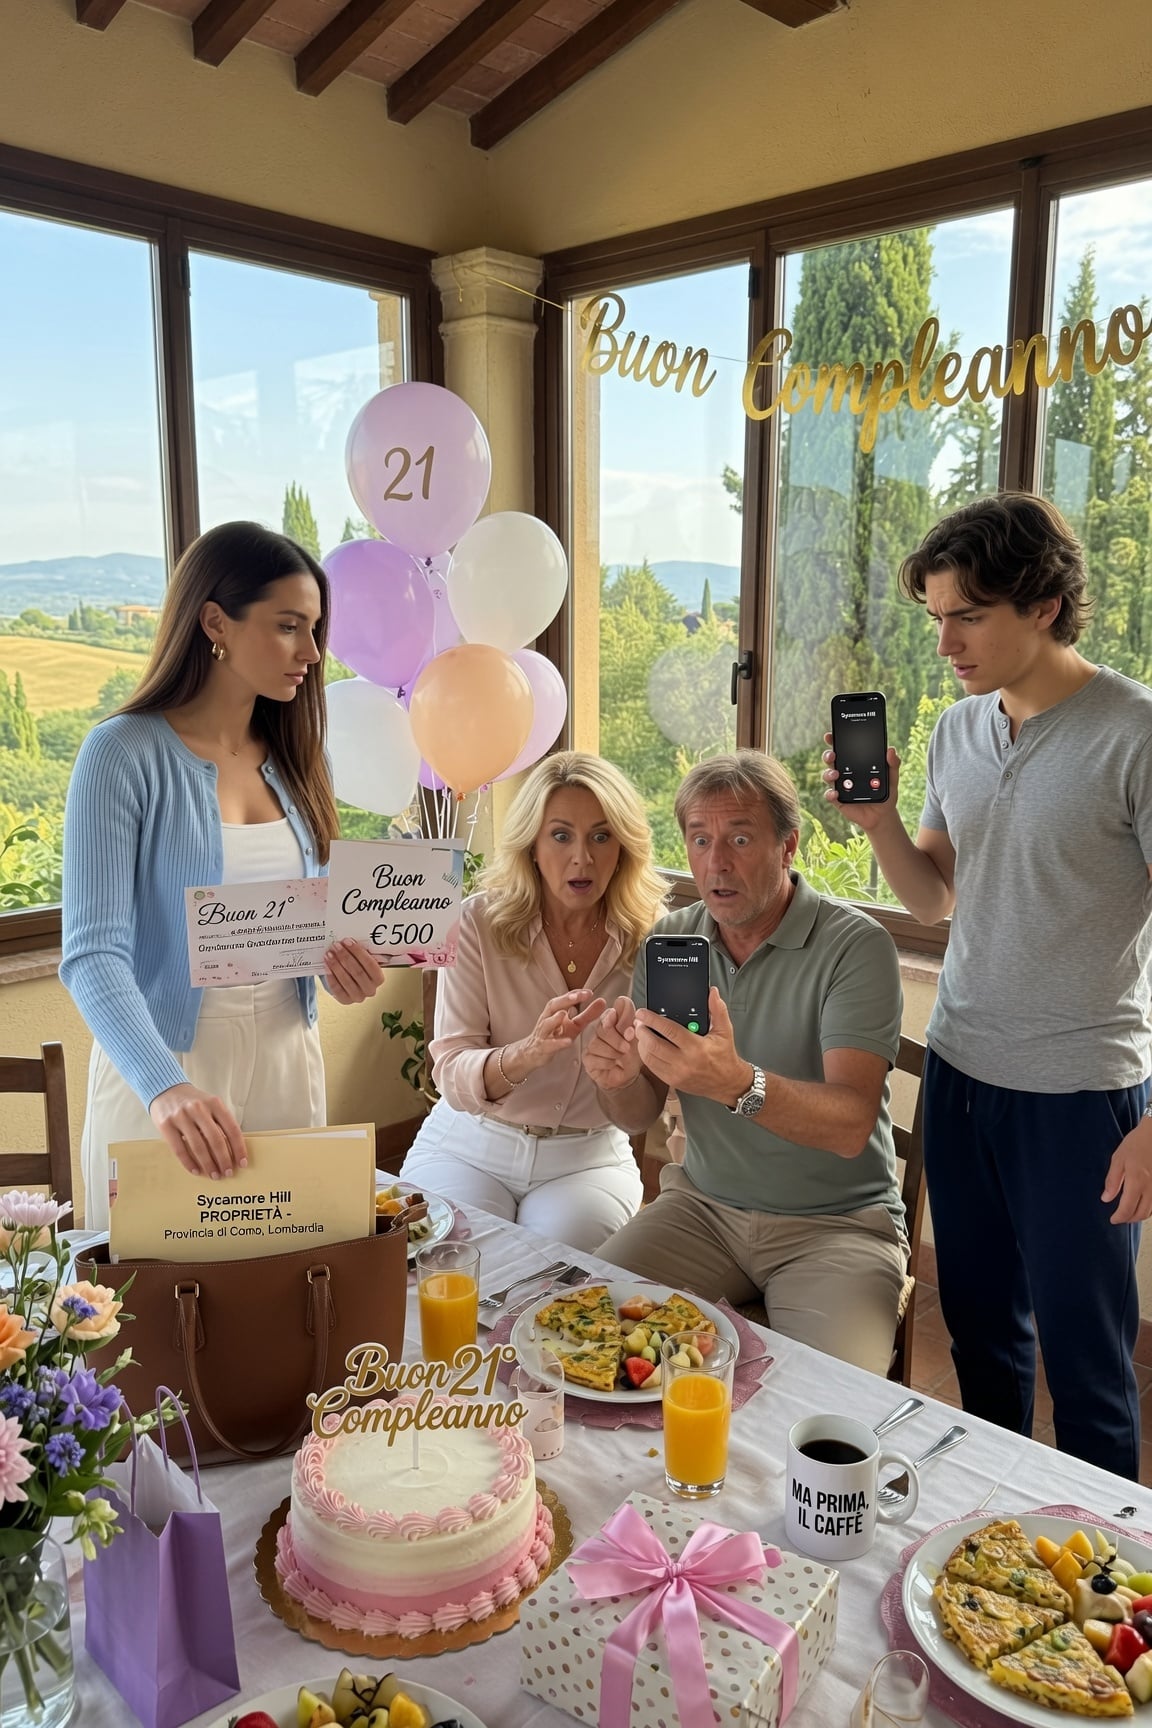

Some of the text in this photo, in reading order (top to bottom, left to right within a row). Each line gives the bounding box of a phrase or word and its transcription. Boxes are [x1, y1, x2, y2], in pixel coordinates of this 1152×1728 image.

[579, 291, 1152, 453] Buon Compleanno
[384, 445, 434, 501] 21
[372, 864, 426, 889] Buon
[198, 902, 258, 926] Buon
[341, 888, 453, 918] Compleanno
[369, 923, 434, 946] €500
[196, 1191, 292, 1208] Sycamore Hill
[200, 1206, 283, 1222] PROPRIETÀ
[345, 1343, 449, 1396] Buon
[306, 1387, 529, 1447] Compleanno
[792, 1478, 869, 1513] MA PRIMA,
[798, 1506, 810, 1530] IL
